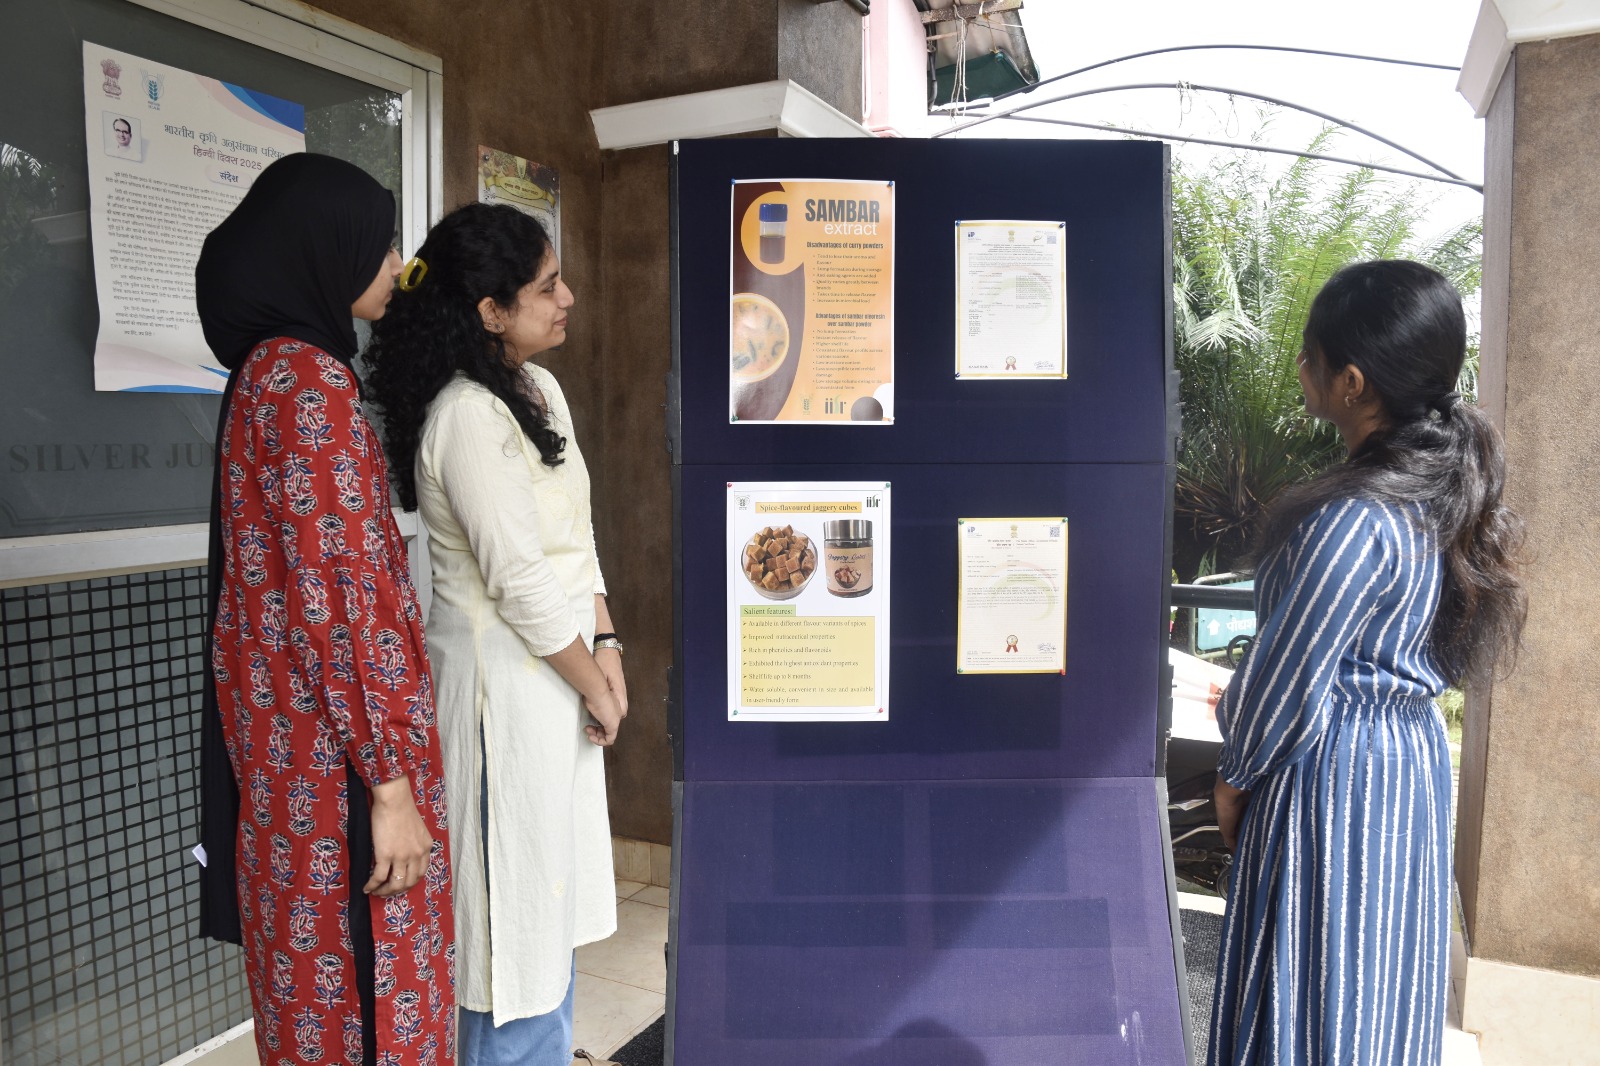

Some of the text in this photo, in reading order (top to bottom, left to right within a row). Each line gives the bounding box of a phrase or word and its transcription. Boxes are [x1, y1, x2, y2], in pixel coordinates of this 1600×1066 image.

[164, 124, 195, 140] भारतीय
[199, 132, 217, 144] कृषि
[221, 138, 258, 152] अनुसंधान
[217, 150, 238, 165] दिवस
[240, 158, 262, 170] 2025
[219, 171, 239, 183] संदेश
[805, 199, 880, 222] SAMBAR
[824, 221, 877, 235] extract
[9, 443, 152, 473] SILVER
